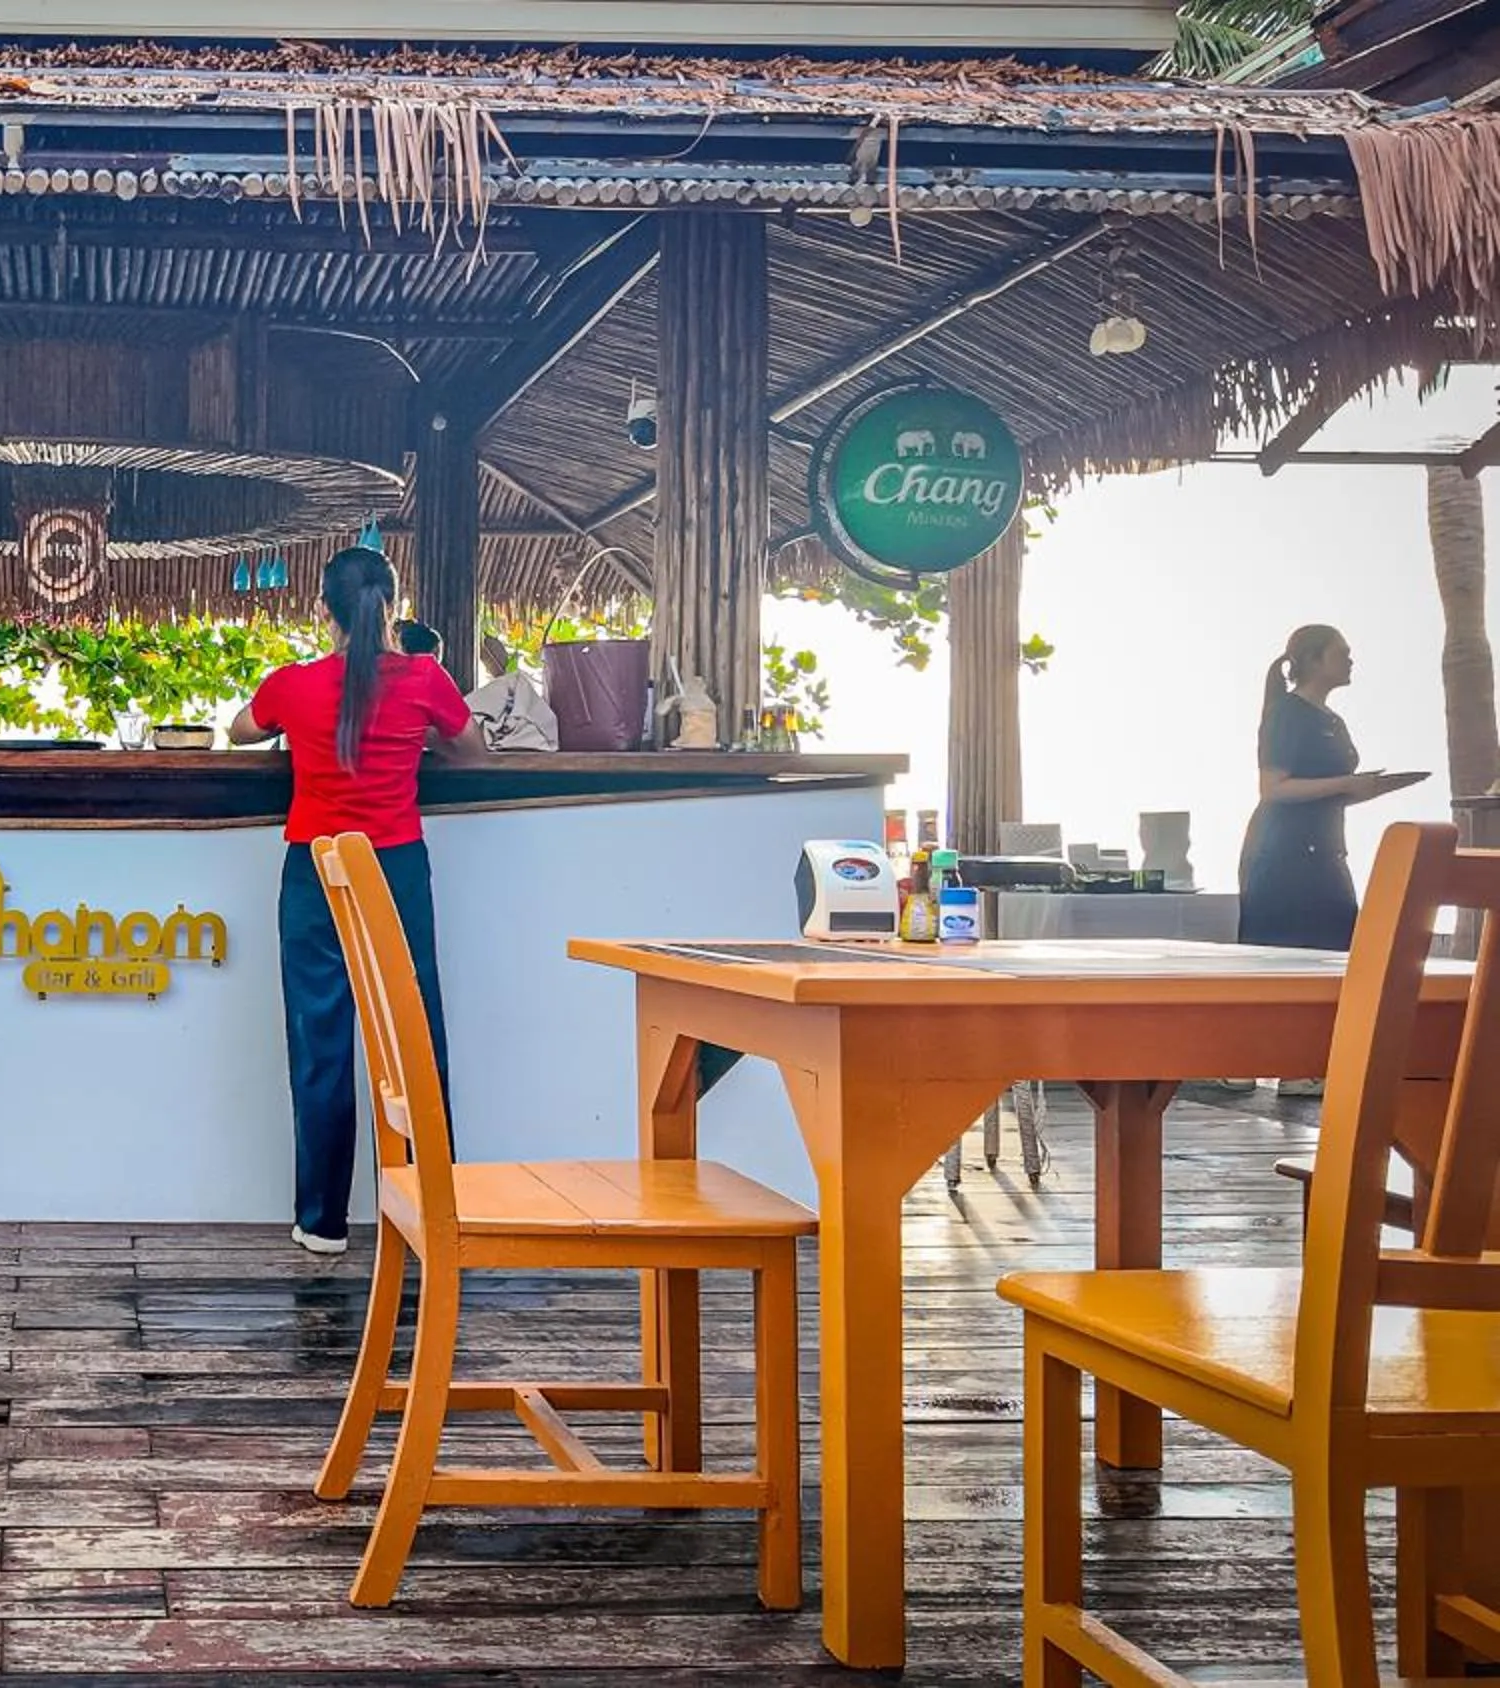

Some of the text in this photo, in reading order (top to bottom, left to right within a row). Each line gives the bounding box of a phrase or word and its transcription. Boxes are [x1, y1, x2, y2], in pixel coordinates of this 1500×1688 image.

[863, 463, 1008, 516] Chang
[83, 967, 101, 988] &
[111, 967, 156, 988] Grill
